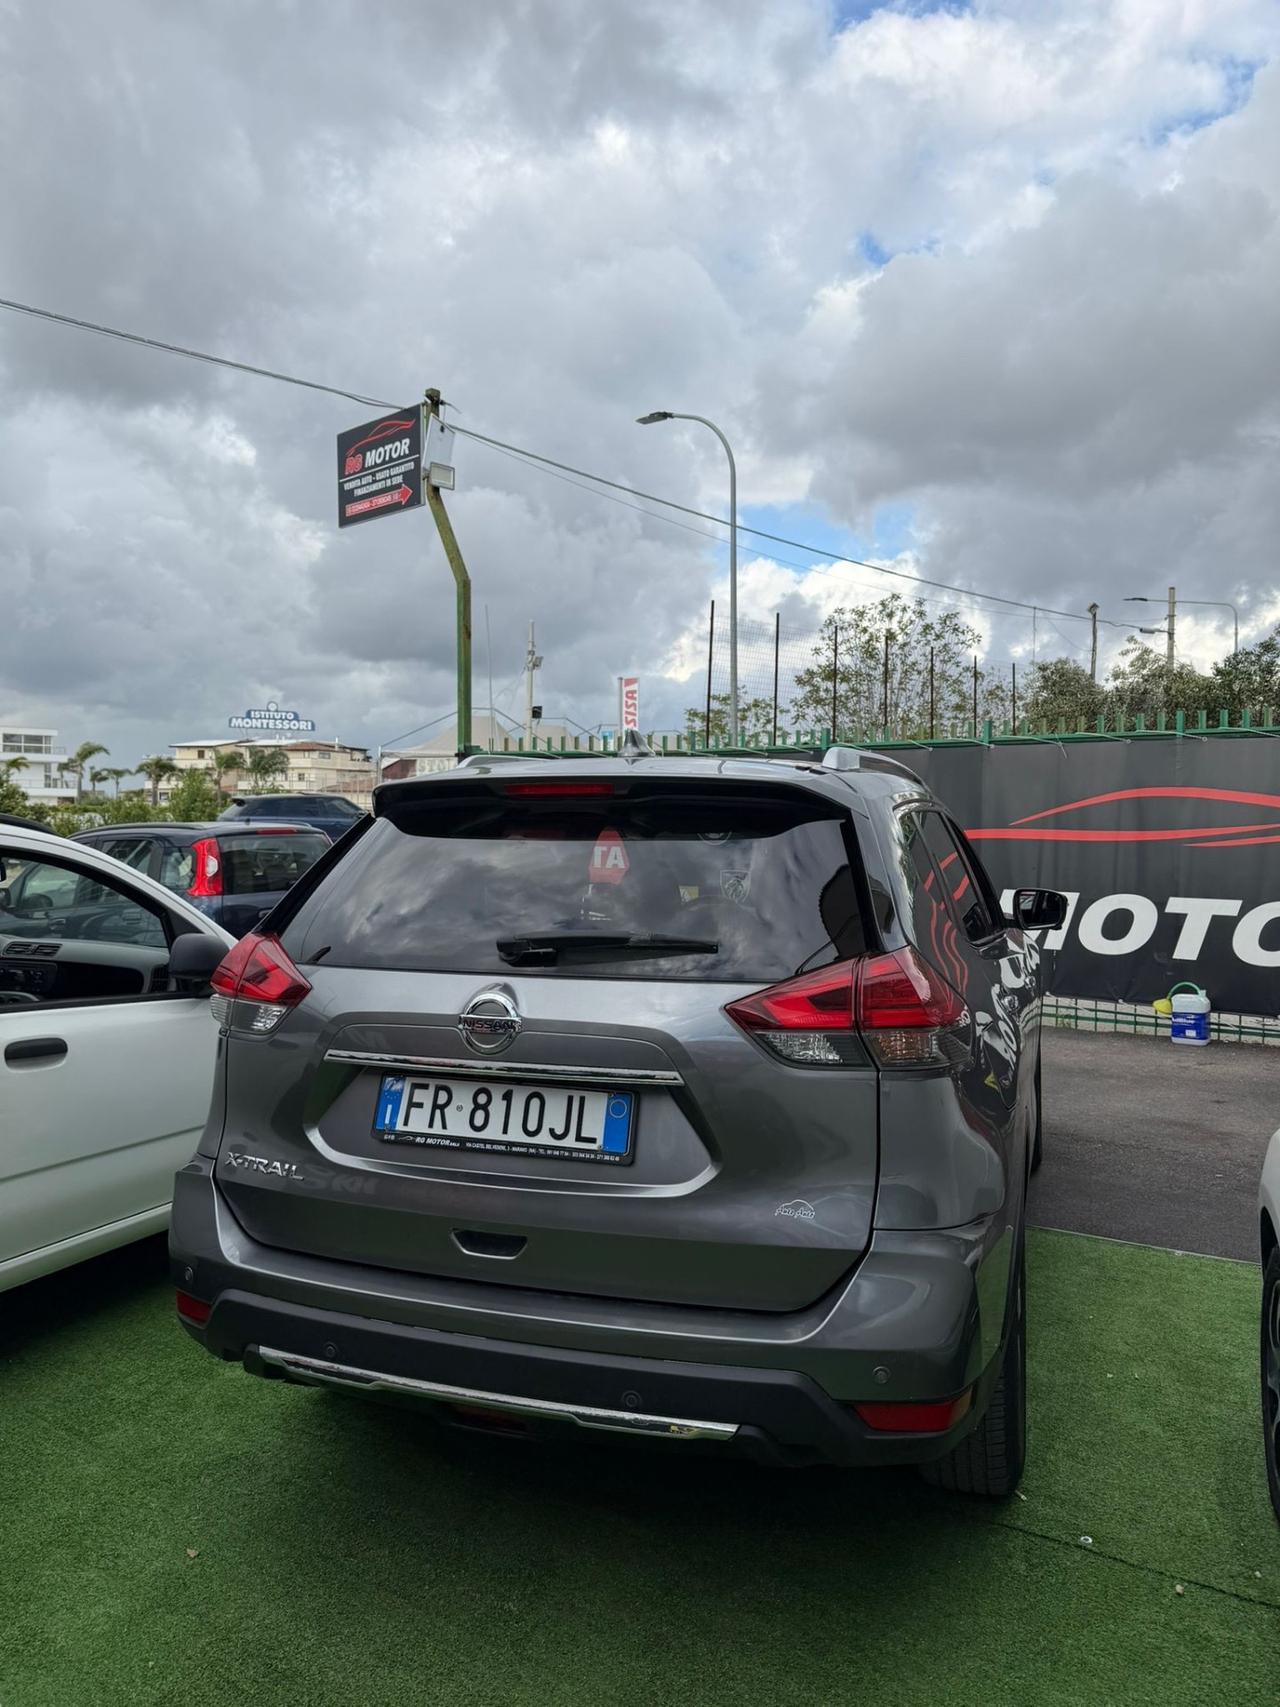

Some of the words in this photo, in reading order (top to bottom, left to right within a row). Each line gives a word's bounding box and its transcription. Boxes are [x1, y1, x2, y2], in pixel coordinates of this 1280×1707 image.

[365, 438, 410, 468] MOTOR
[361, 475, 373, 485] AUTO
[624, 689, 637, 728] SISA
[250, 711, 295, 720] ISTITUTO
[230, 718, 313, 730] MONTESSORI
[463, 1019, 515, 1031] NISSAN
[403, 1082, 454, 1131] FR
[468, 1086, 598, 1145] 810JL
[415, 1136, 426, 1144] RG
[426, 1137, 450, 1147] MOTOR
[225, 1151, 305, 1180] X-TRAIL
